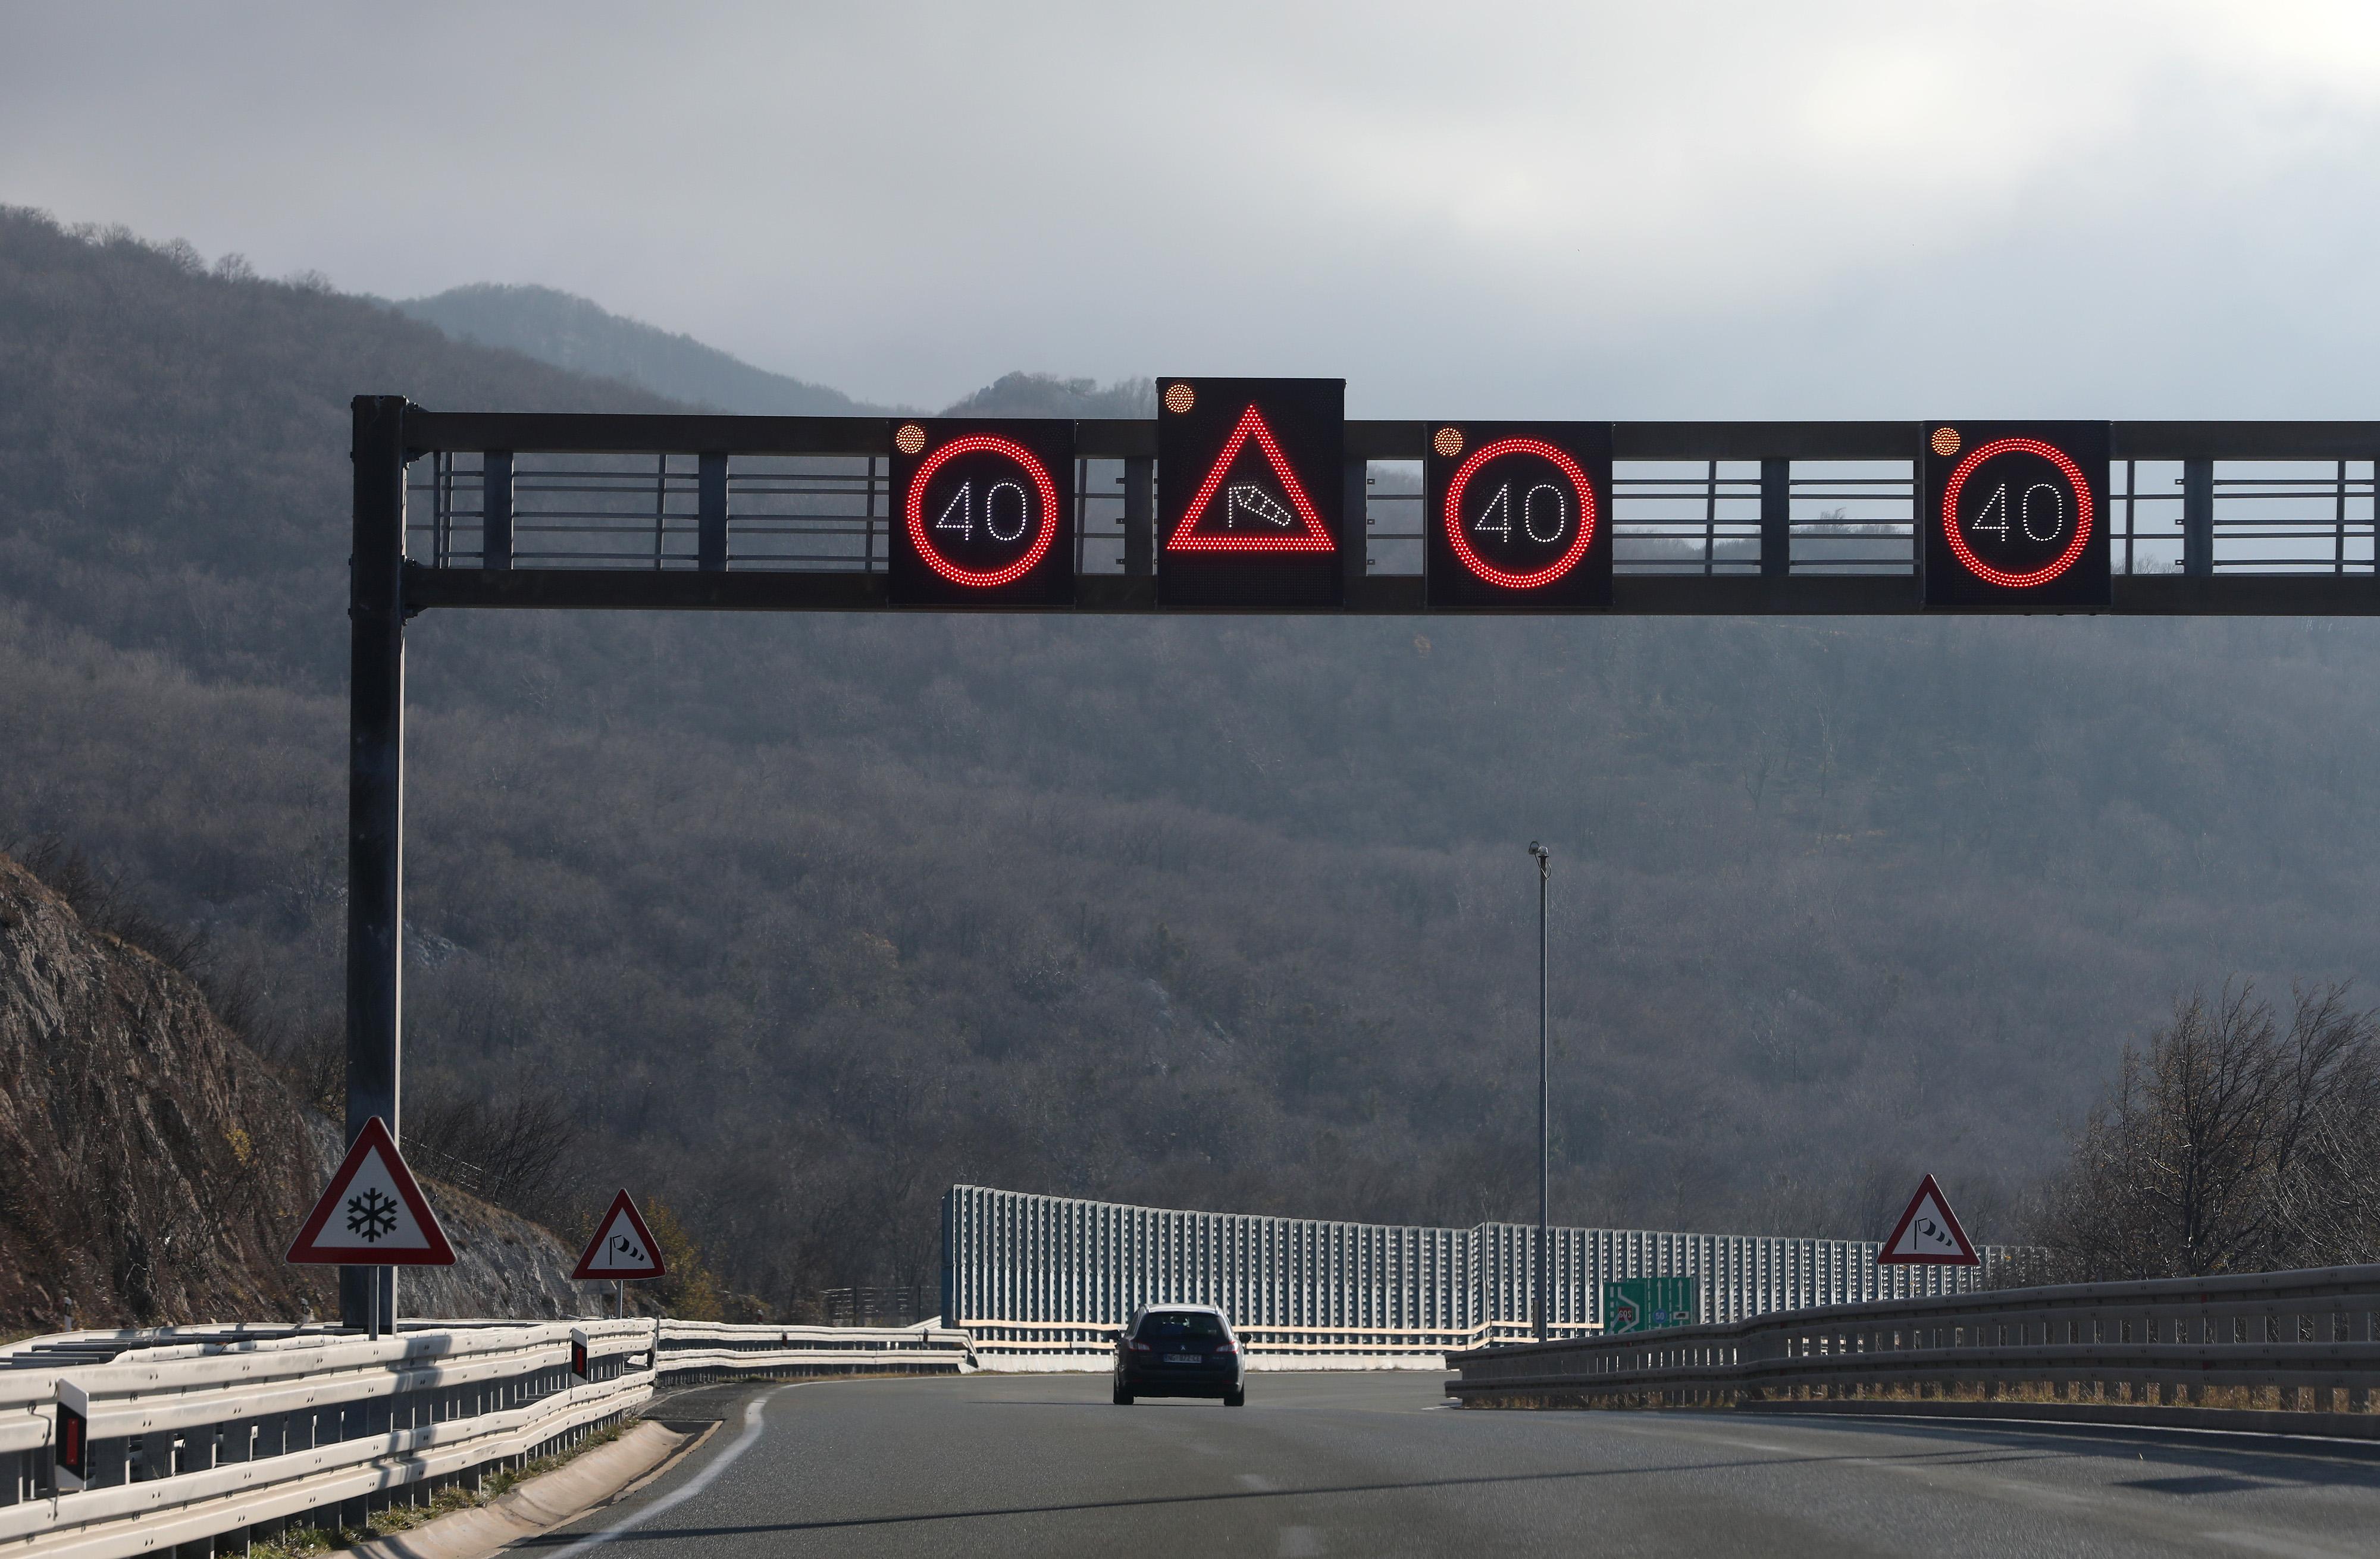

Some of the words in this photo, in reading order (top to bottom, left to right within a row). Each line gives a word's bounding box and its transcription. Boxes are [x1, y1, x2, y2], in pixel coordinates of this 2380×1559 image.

[935, 481, 1028, 542] 40
[1474, 483, 1565, 543] 40
[1971, 482, 2063, 542] 40
